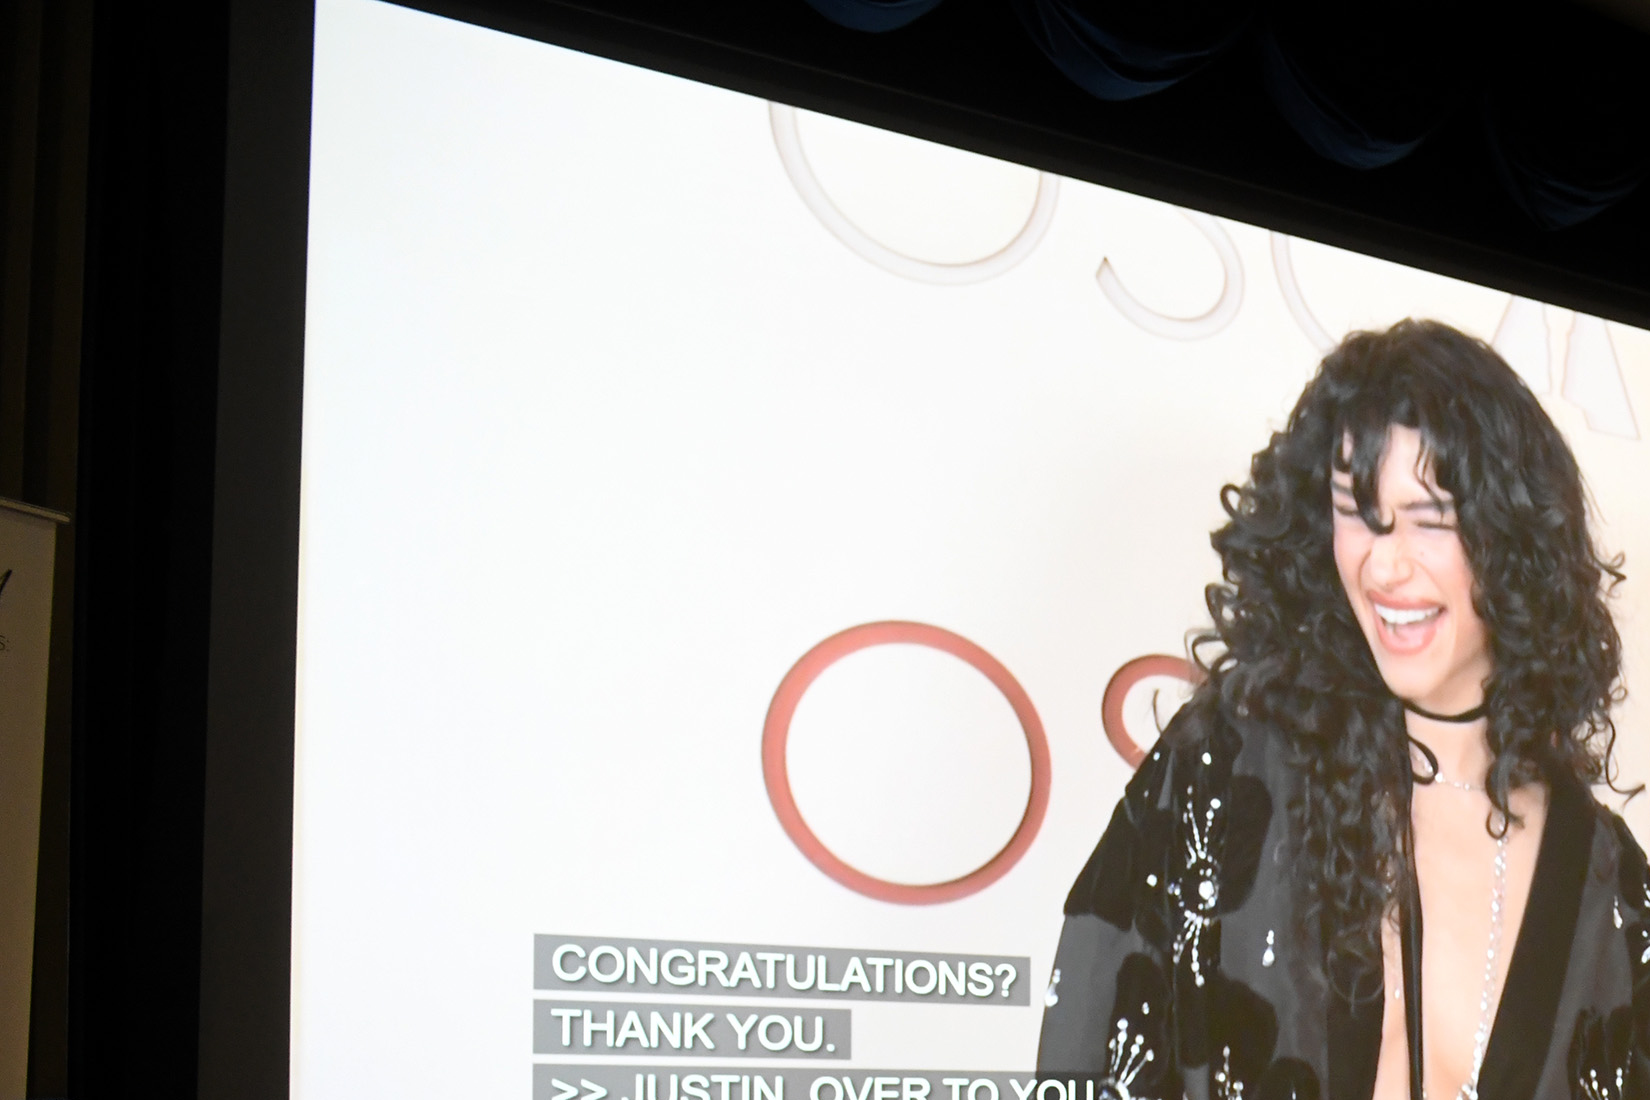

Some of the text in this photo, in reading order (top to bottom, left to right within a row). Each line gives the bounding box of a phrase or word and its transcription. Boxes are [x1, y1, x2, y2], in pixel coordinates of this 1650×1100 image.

[552, 944, 1017, 998] CONGRATULATIONS?
[551, 1008, 836, 1052] THANK YOU.
